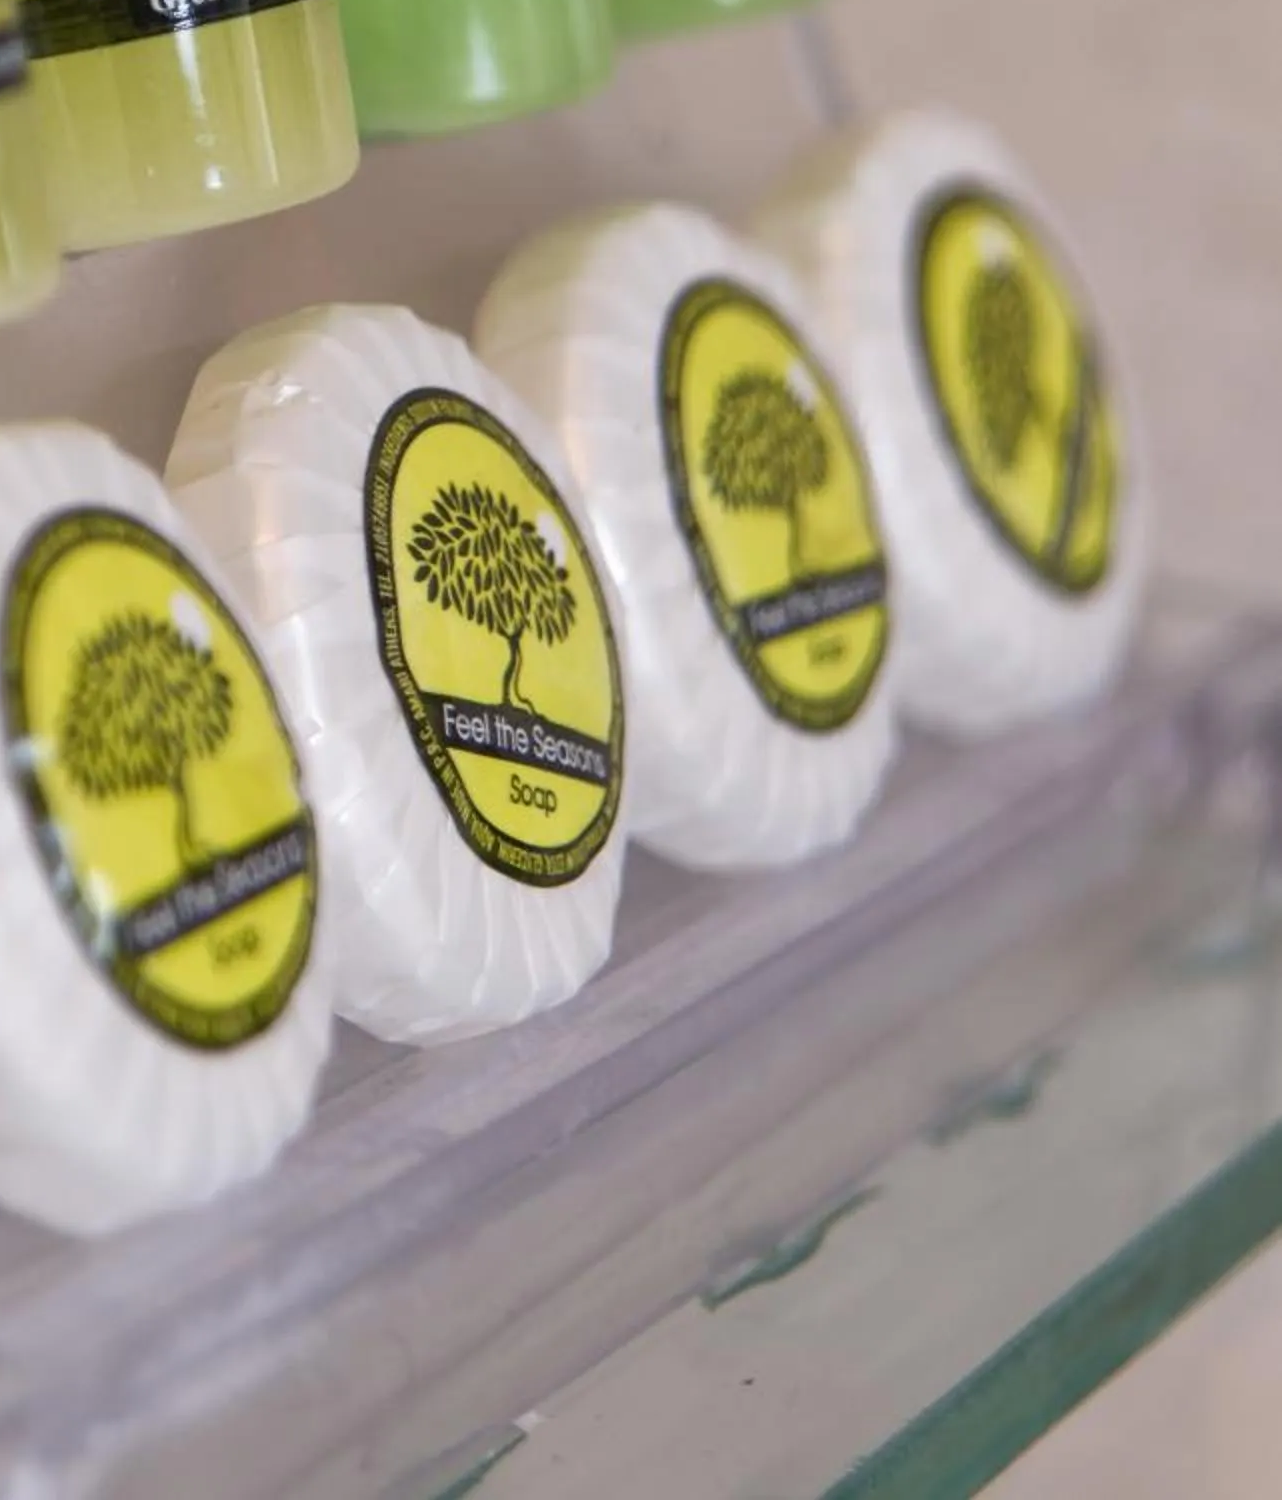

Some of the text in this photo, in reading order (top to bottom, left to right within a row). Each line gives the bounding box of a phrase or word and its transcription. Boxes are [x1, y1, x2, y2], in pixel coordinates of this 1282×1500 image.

[442, 703, 606, 778] Feel the Seasons
[510, 773, 558, 818] Soap
